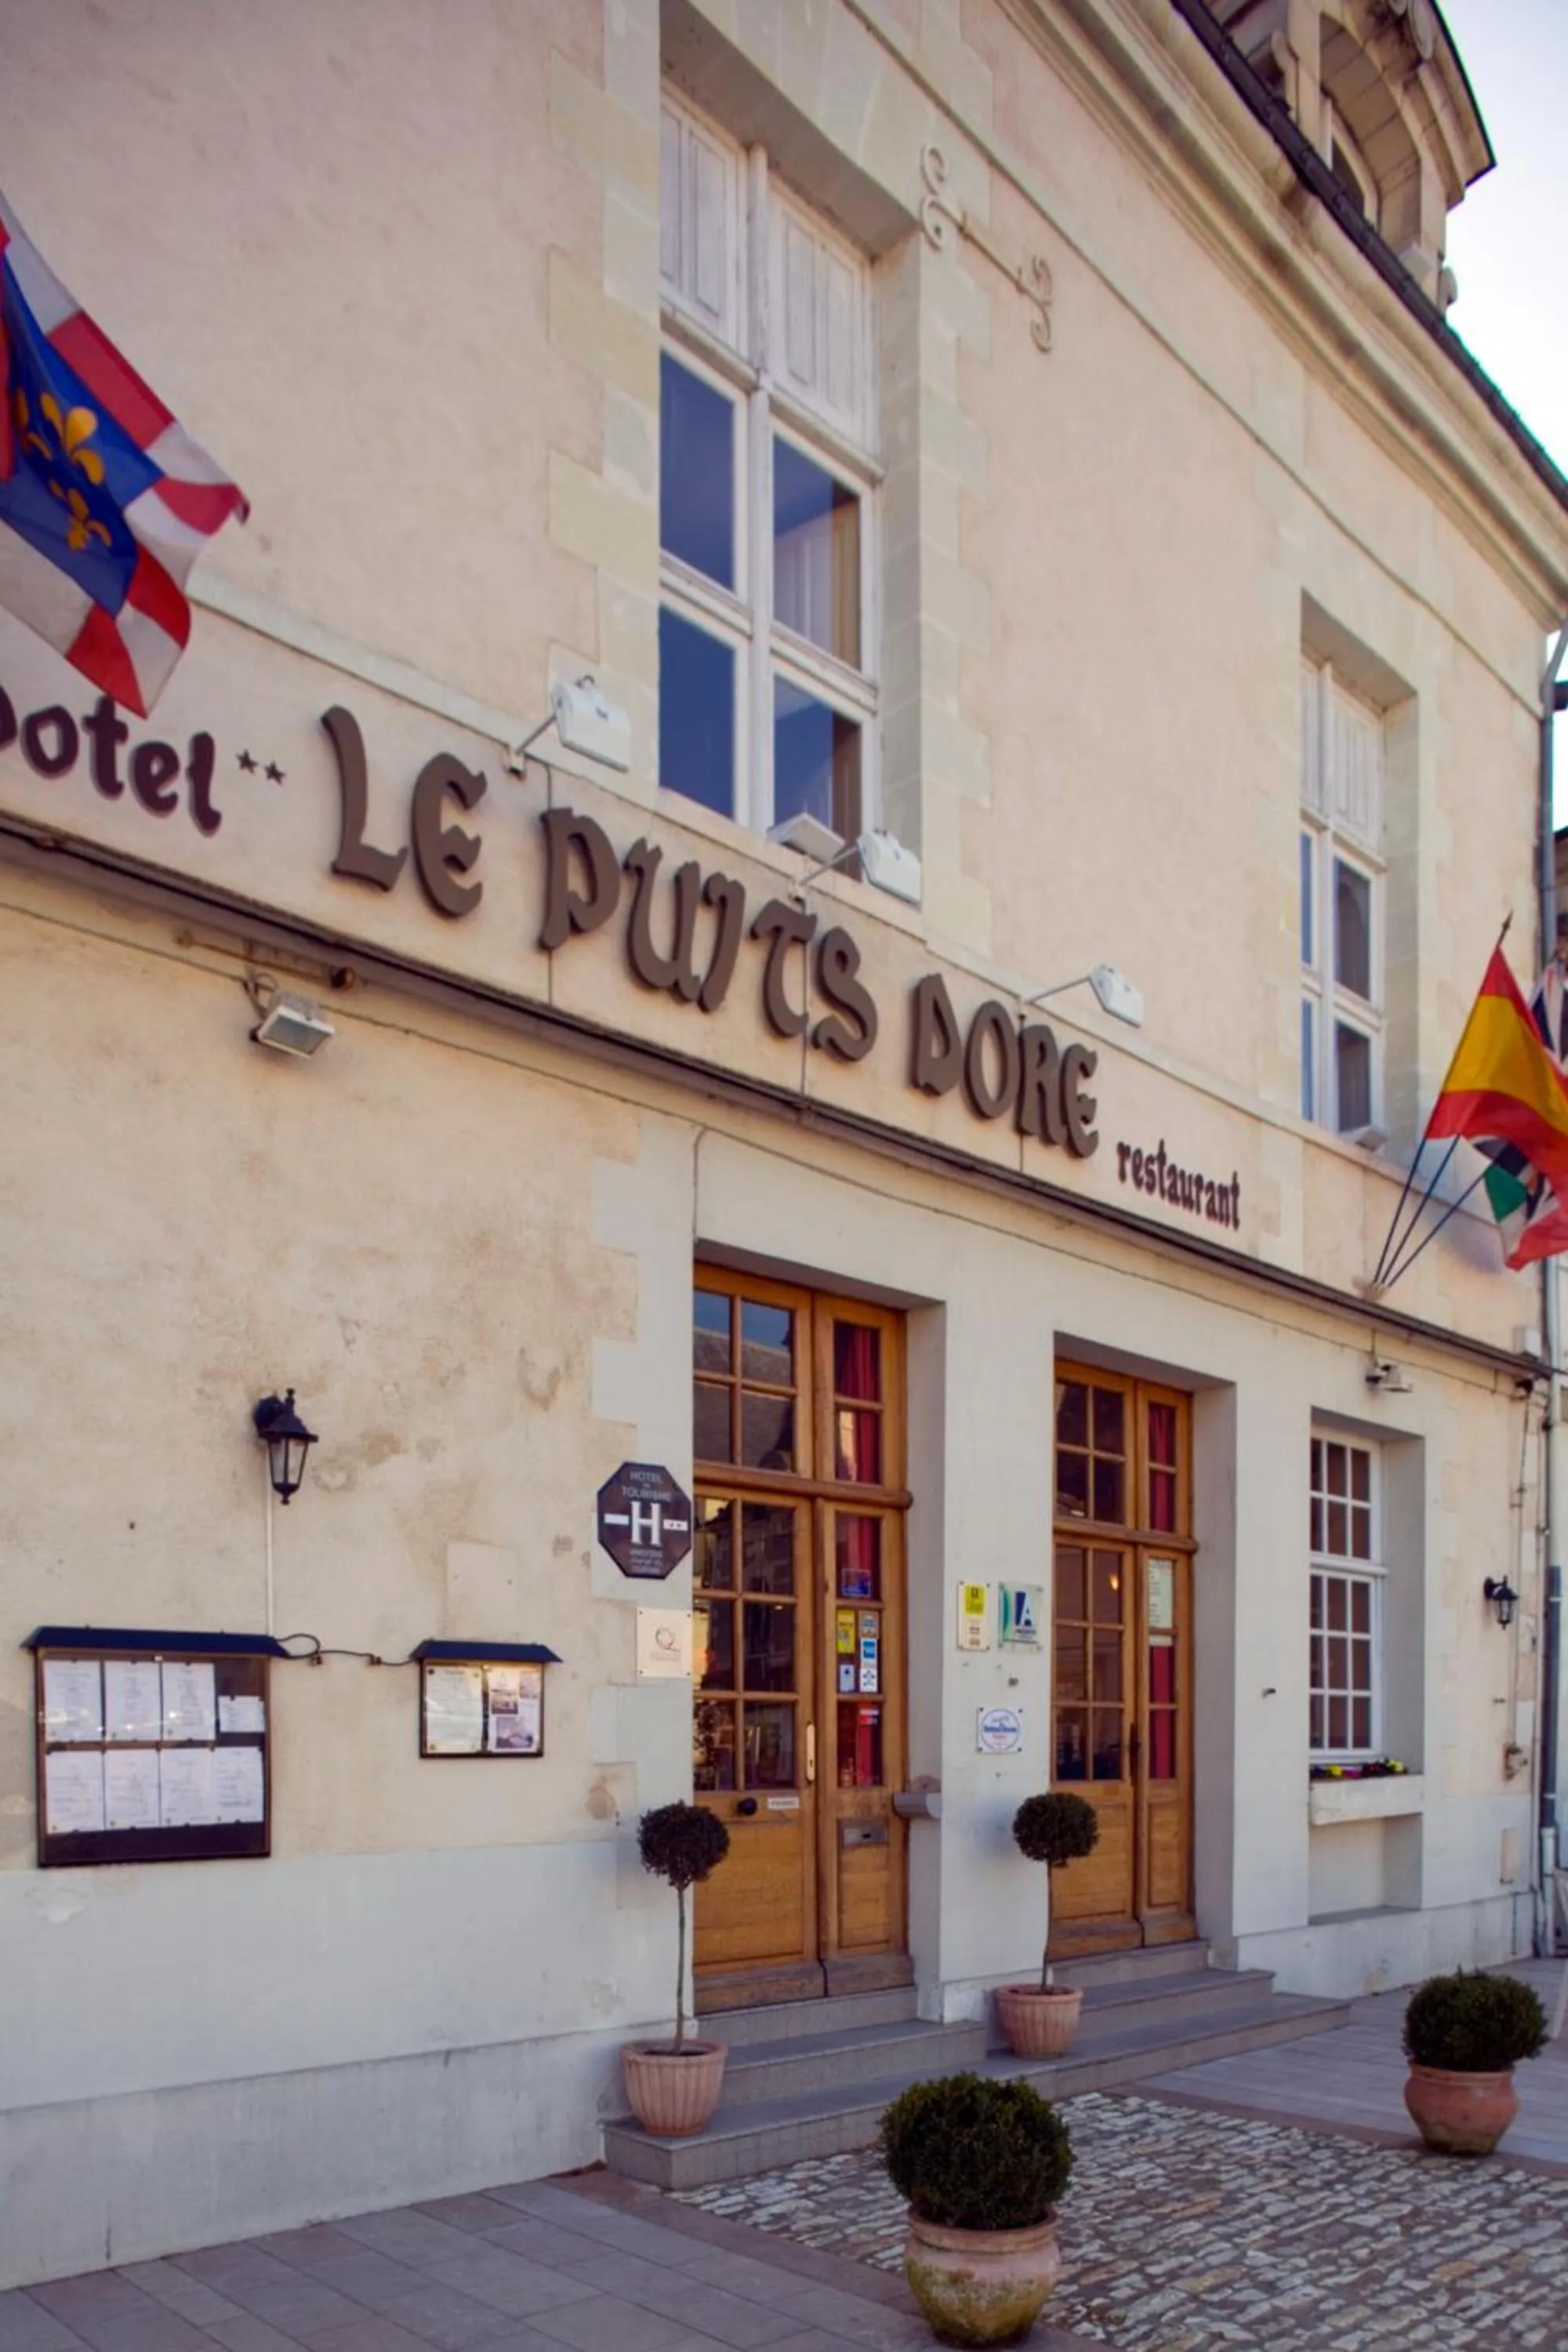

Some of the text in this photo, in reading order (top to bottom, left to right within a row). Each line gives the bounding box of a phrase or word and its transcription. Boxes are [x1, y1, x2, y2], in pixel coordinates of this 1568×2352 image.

[320, 704, 488, 920] LE
[539, 806, 879, 1062] PUITS
[912, 972, 1099, 1159] DORE
[1116, 1138, 1240, 1232] restaurant
[630, 1500, 662, 1548] H
